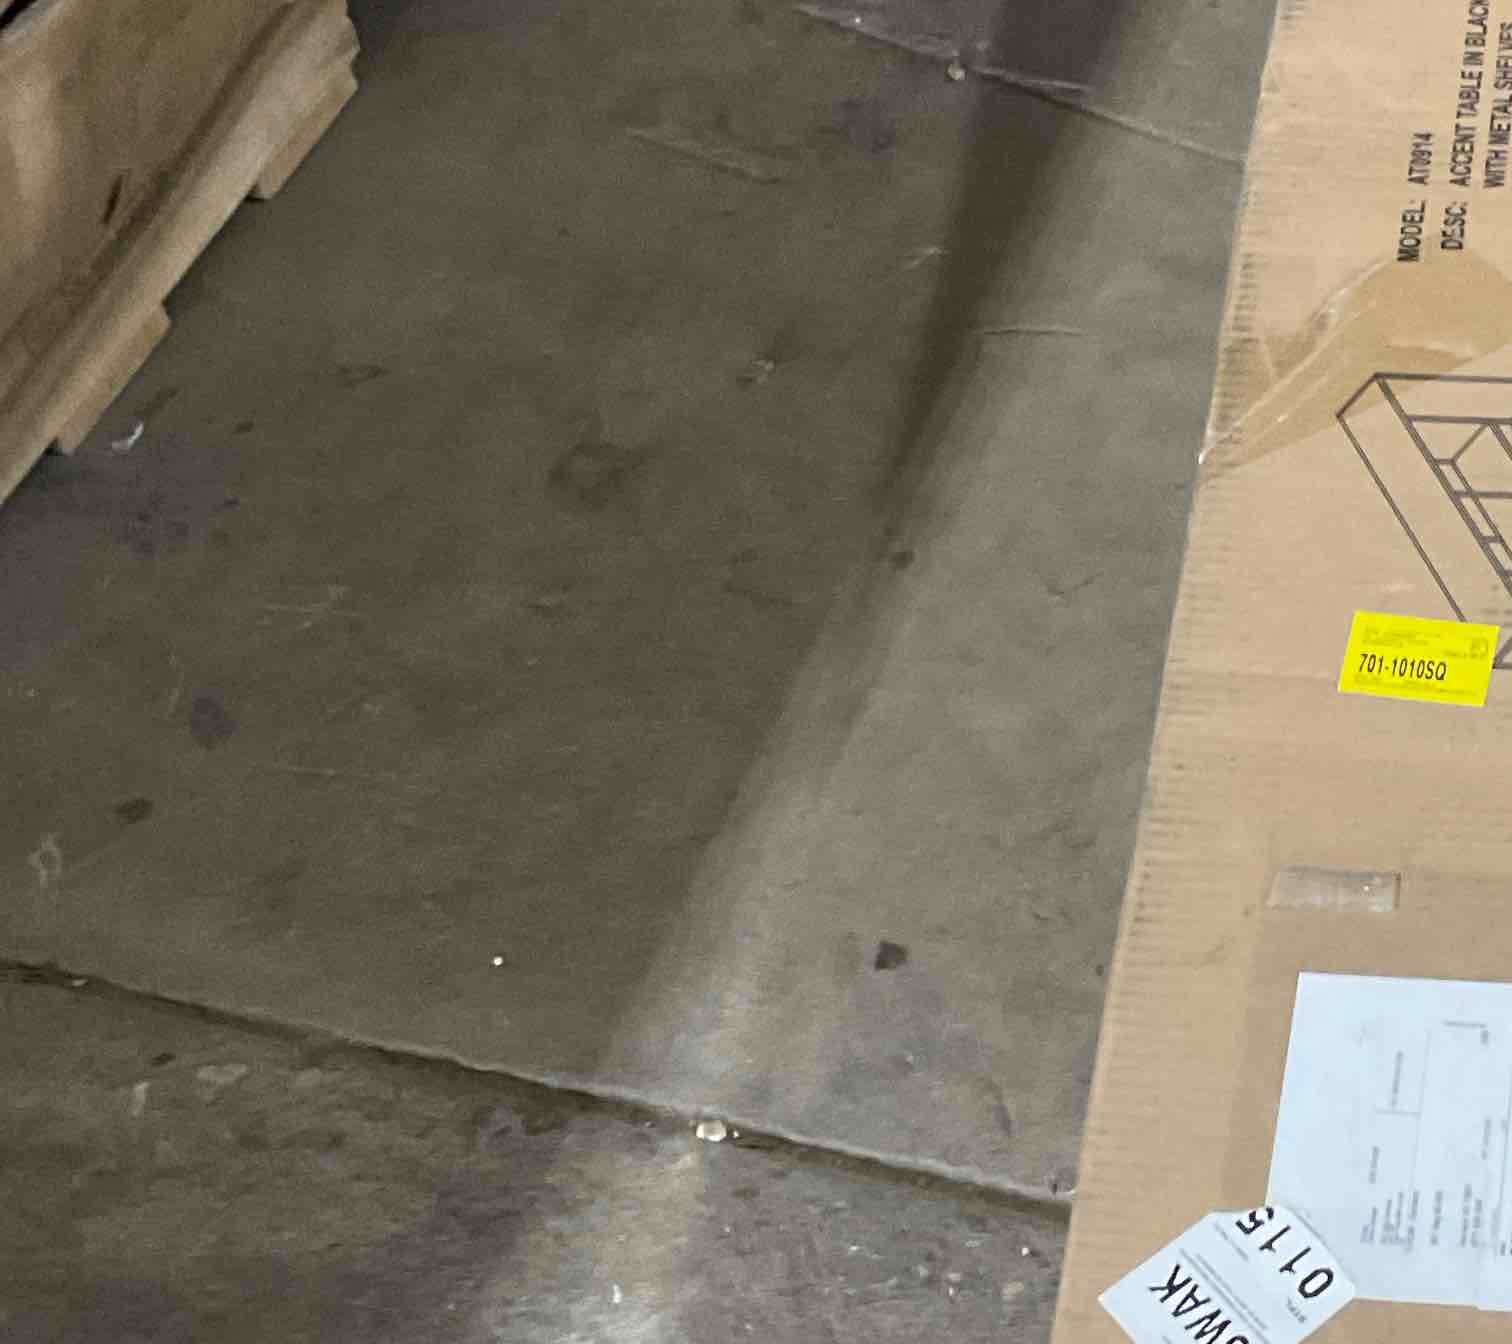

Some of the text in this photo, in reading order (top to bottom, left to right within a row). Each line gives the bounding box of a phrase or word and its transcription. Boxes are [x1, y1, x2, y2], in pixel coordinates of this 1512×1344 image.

[1462, 51, 1484, 66] IN
[1456, 71, 1482, 119] TABLE
[1449, 124, 1476, 187] ACCENT
[1484, 150, 1508, 189] WITH
[1397, 200, 1425, 263] MODEL:
[1441, 202, 1468, 251] DESC:
[1359, 653, 1448, 681] 701-1010SQ
[1235, 1207, 1334, 1299] 0115
